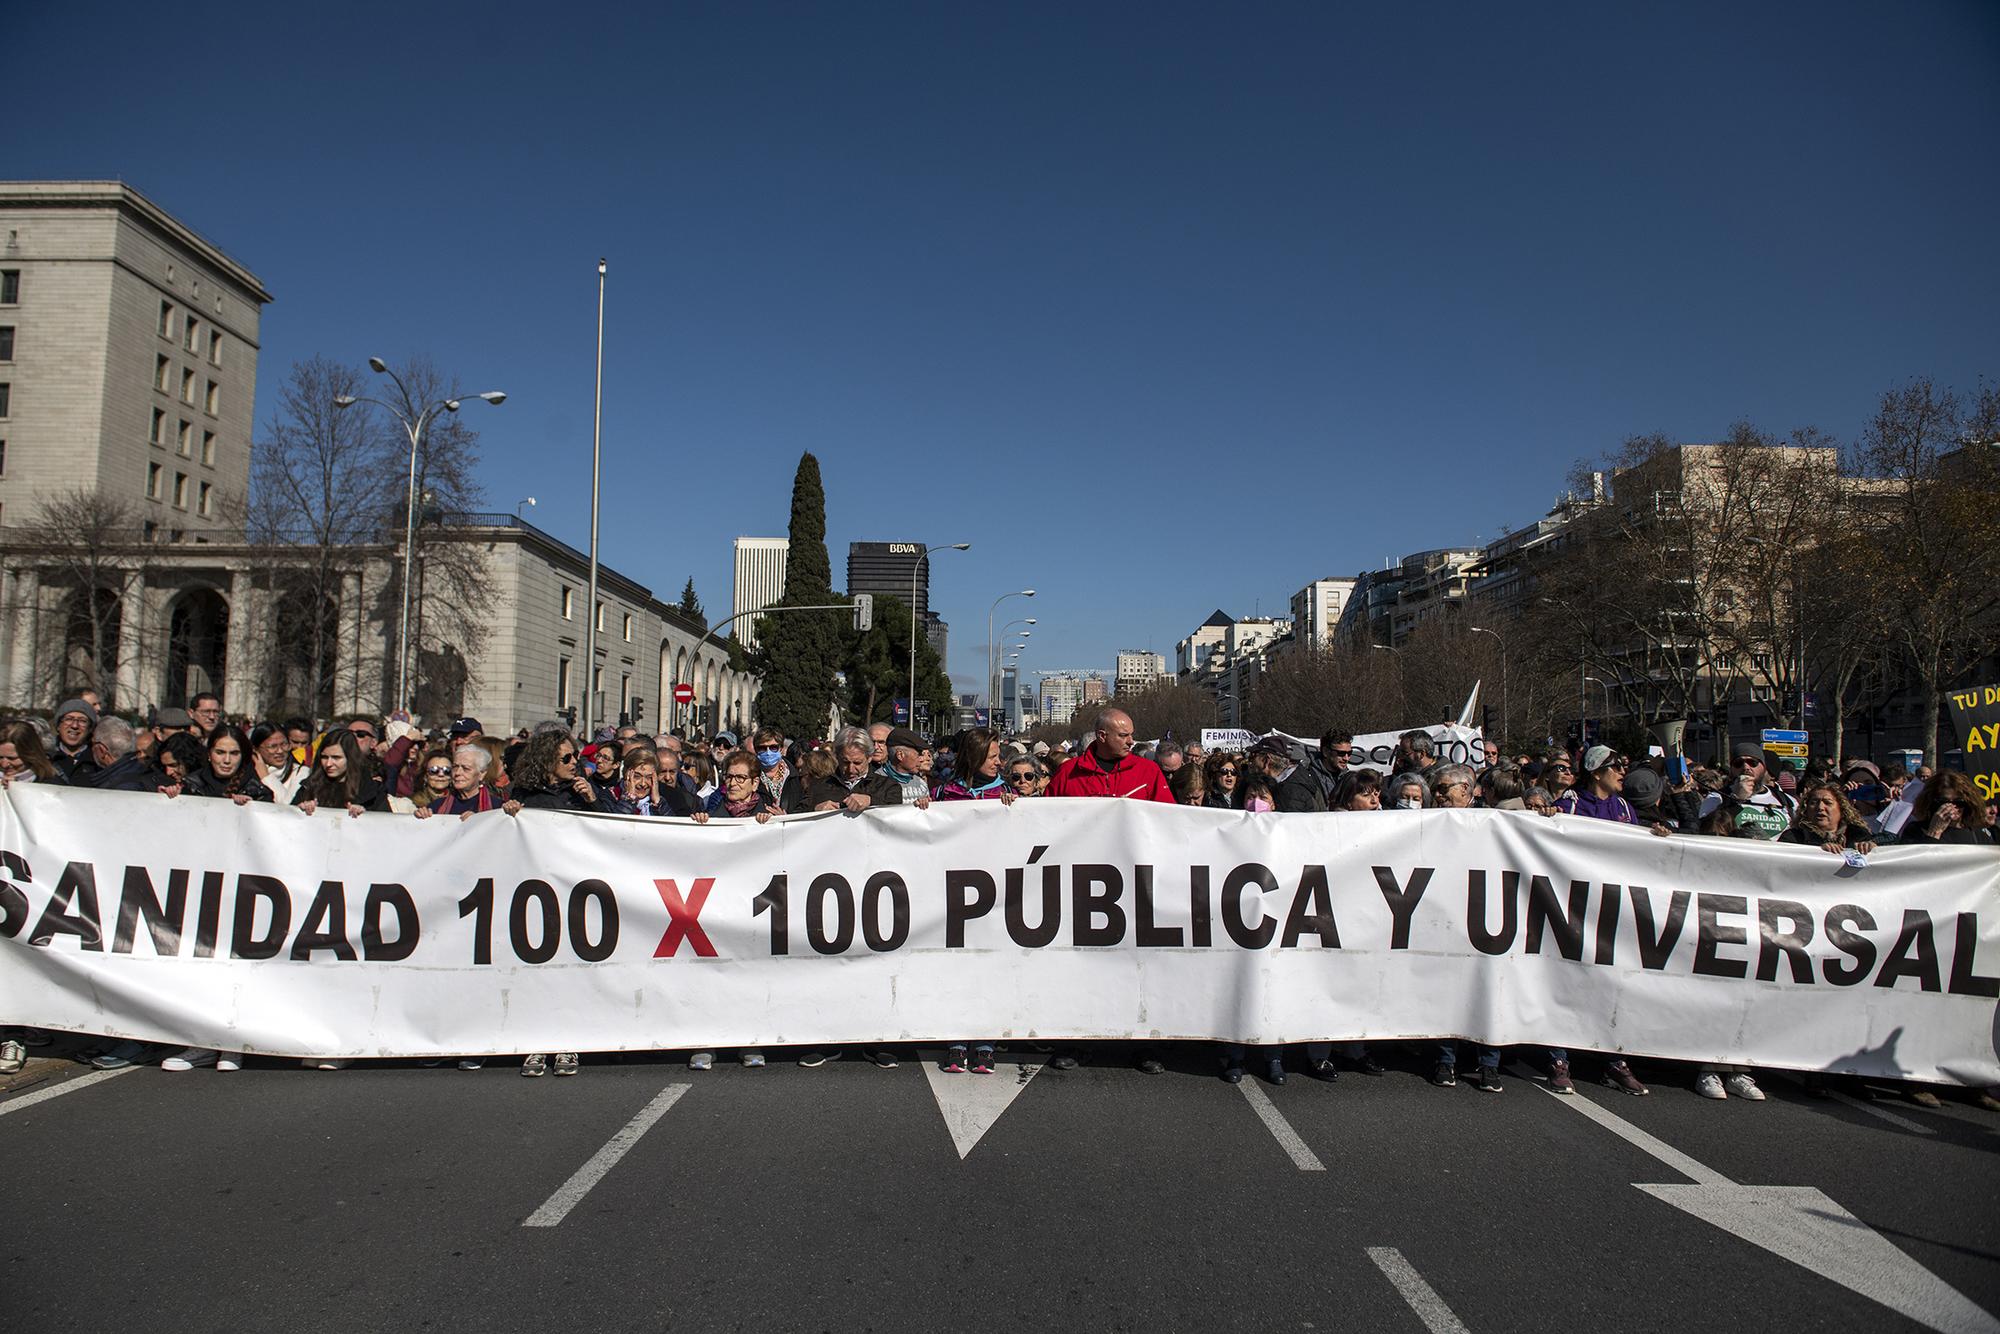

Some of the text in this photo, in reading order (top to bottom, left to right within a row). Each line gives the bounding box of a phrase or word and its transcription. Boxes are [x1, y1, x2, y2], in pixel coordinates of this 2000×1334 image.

[890, 544, 915, 553] BBVA
[1952, 692, 1978, 710] TU
[1741, 812, 1781, 822] SANIDAD
[458, 877, 619, 965] 100
[653, 877, 718, 958] X
[753, 871, 910, 956] 100
[946, 845, 1341, 949] PÚBLICA
[1371, 866, 1435, 950] Y
[1467, 869, 2000, 998] UNIVERSAL
